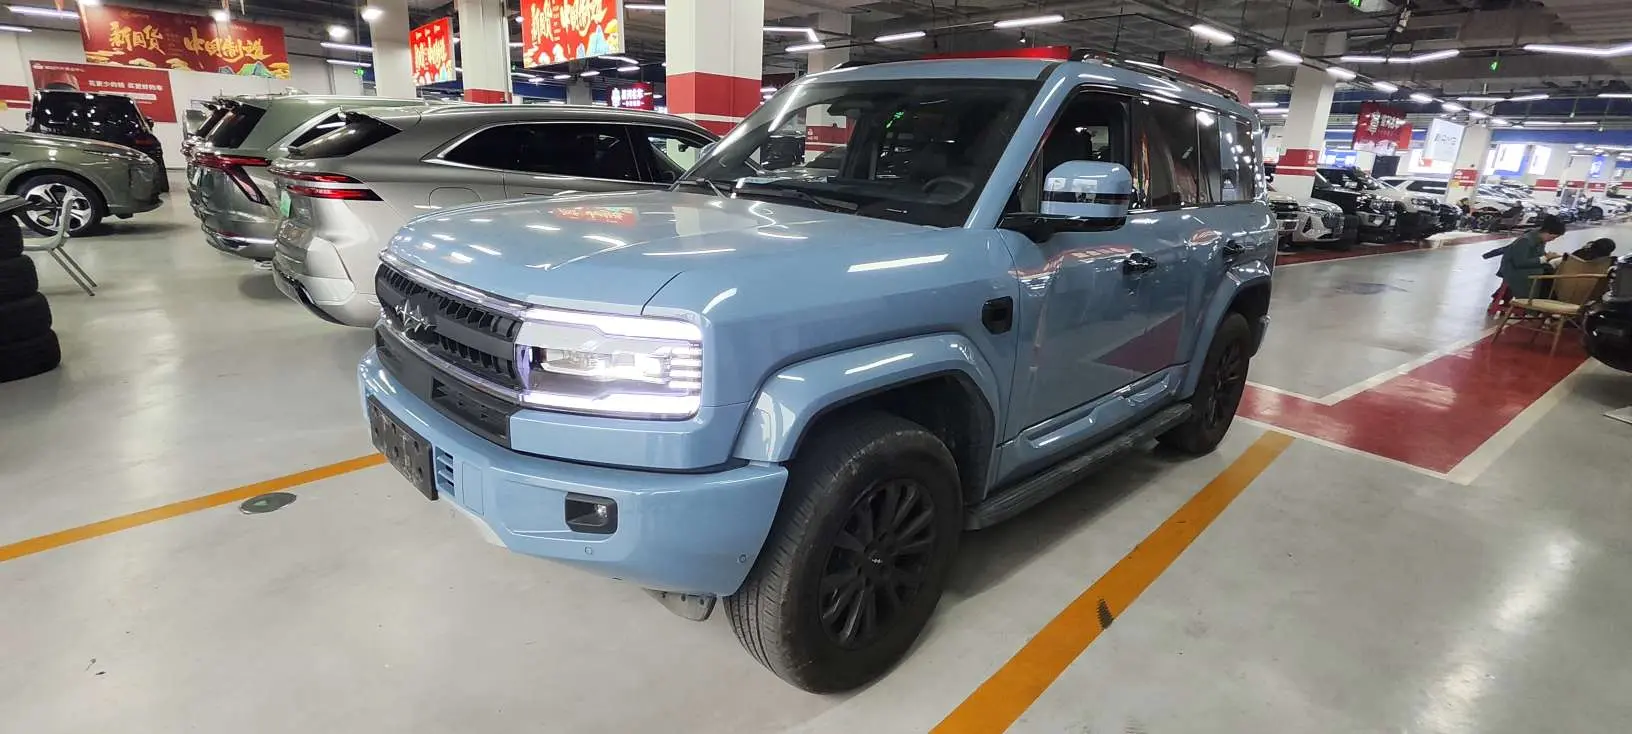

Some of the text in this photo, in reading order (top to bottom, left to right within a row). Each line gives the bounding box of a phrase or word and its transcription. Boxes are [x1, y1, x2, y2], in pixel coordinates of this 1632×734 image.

[109, 20, 166, 56] 新国货
[183, 26, 272, 63] 中国制造
